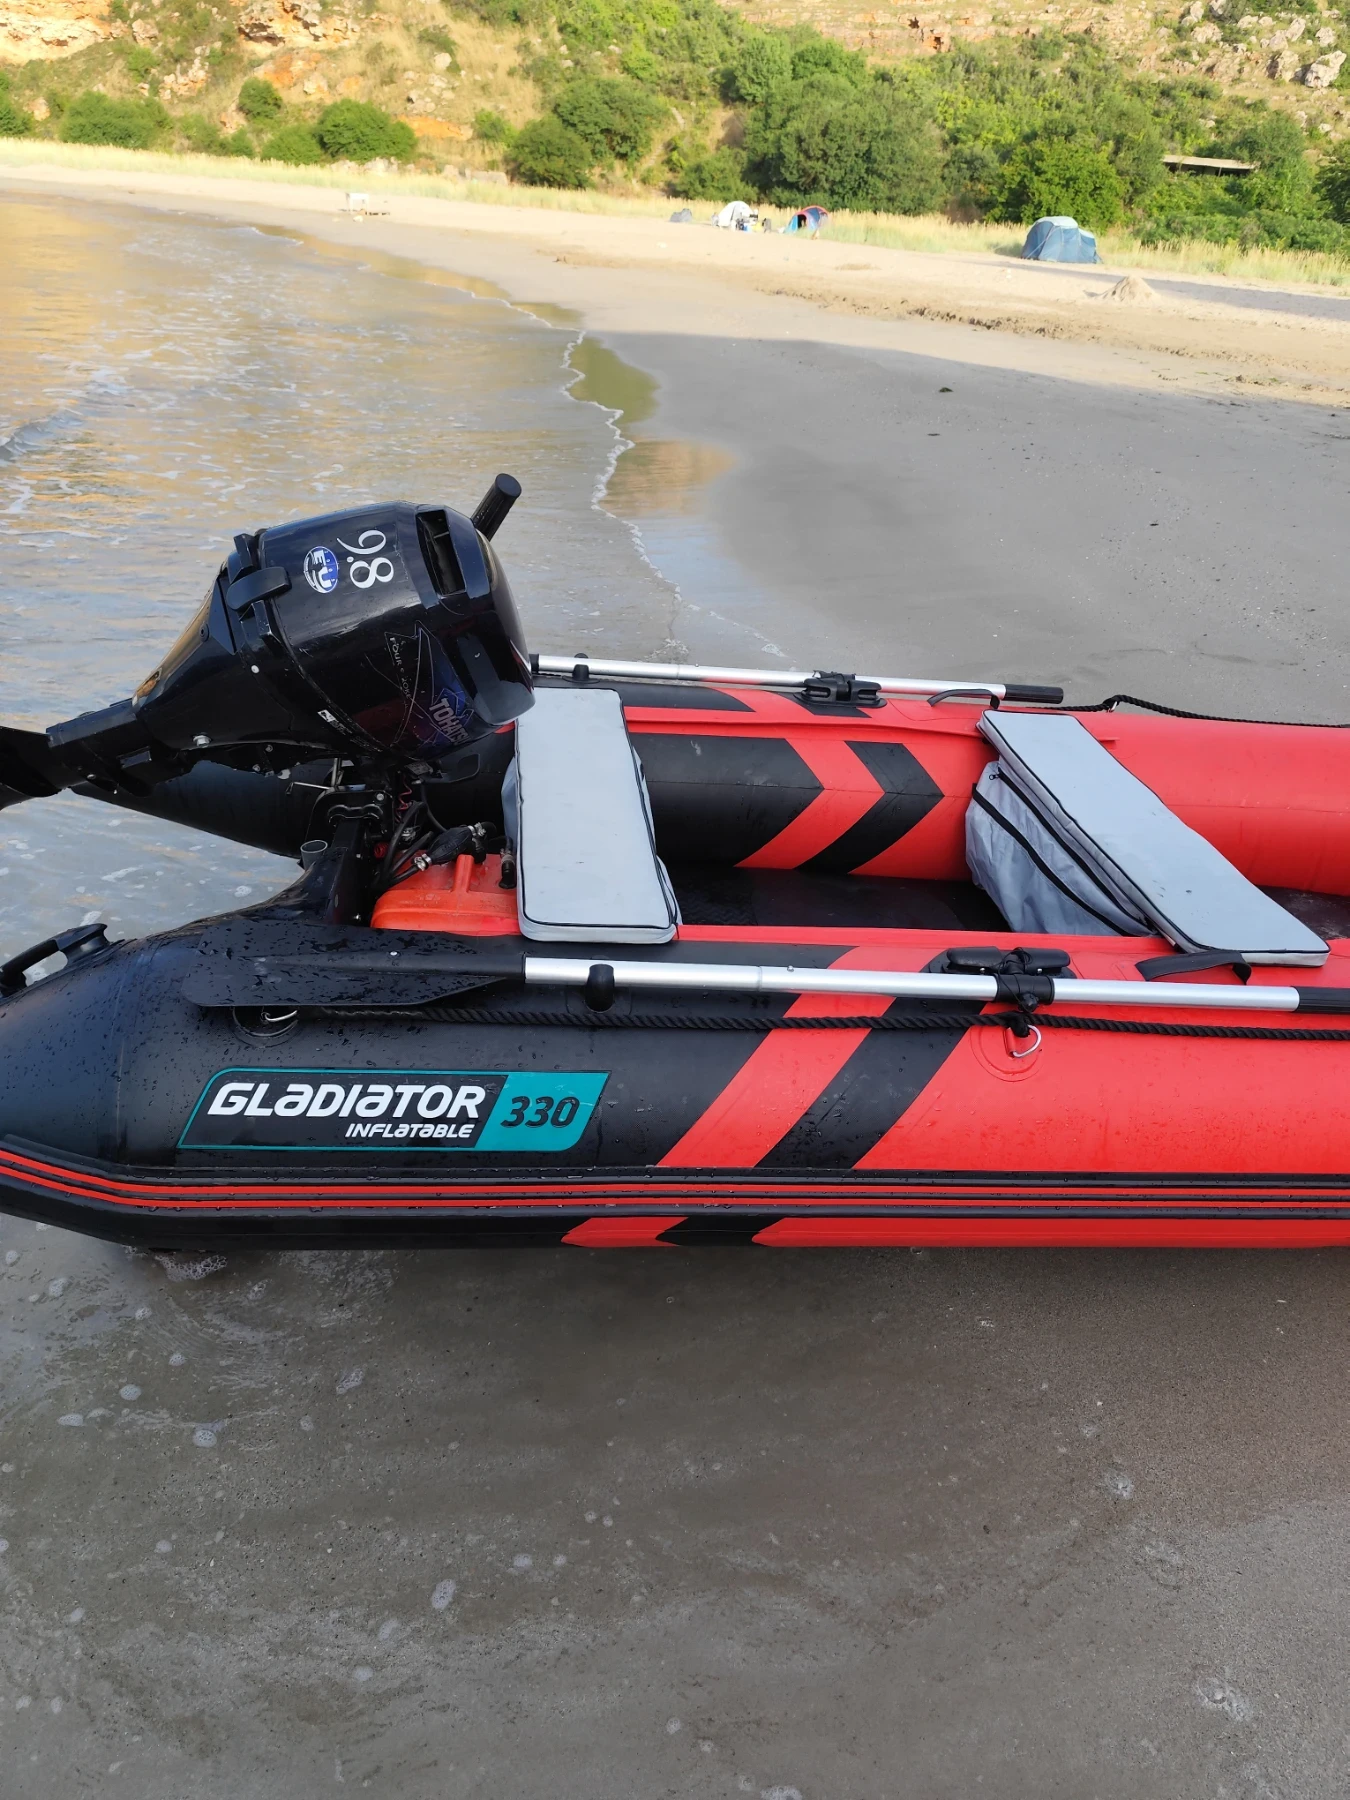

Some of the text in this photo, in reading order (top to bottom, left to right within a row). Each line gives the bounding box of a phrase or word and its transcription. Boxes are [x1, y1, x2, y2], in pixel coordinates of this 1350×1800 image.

[337, 530, 394, 589] 9.8
[389, 637, 402, 666] FOUR
[429, 698, 469, 745] TOHATSU
[500, 1095, 580, 1129] 330
